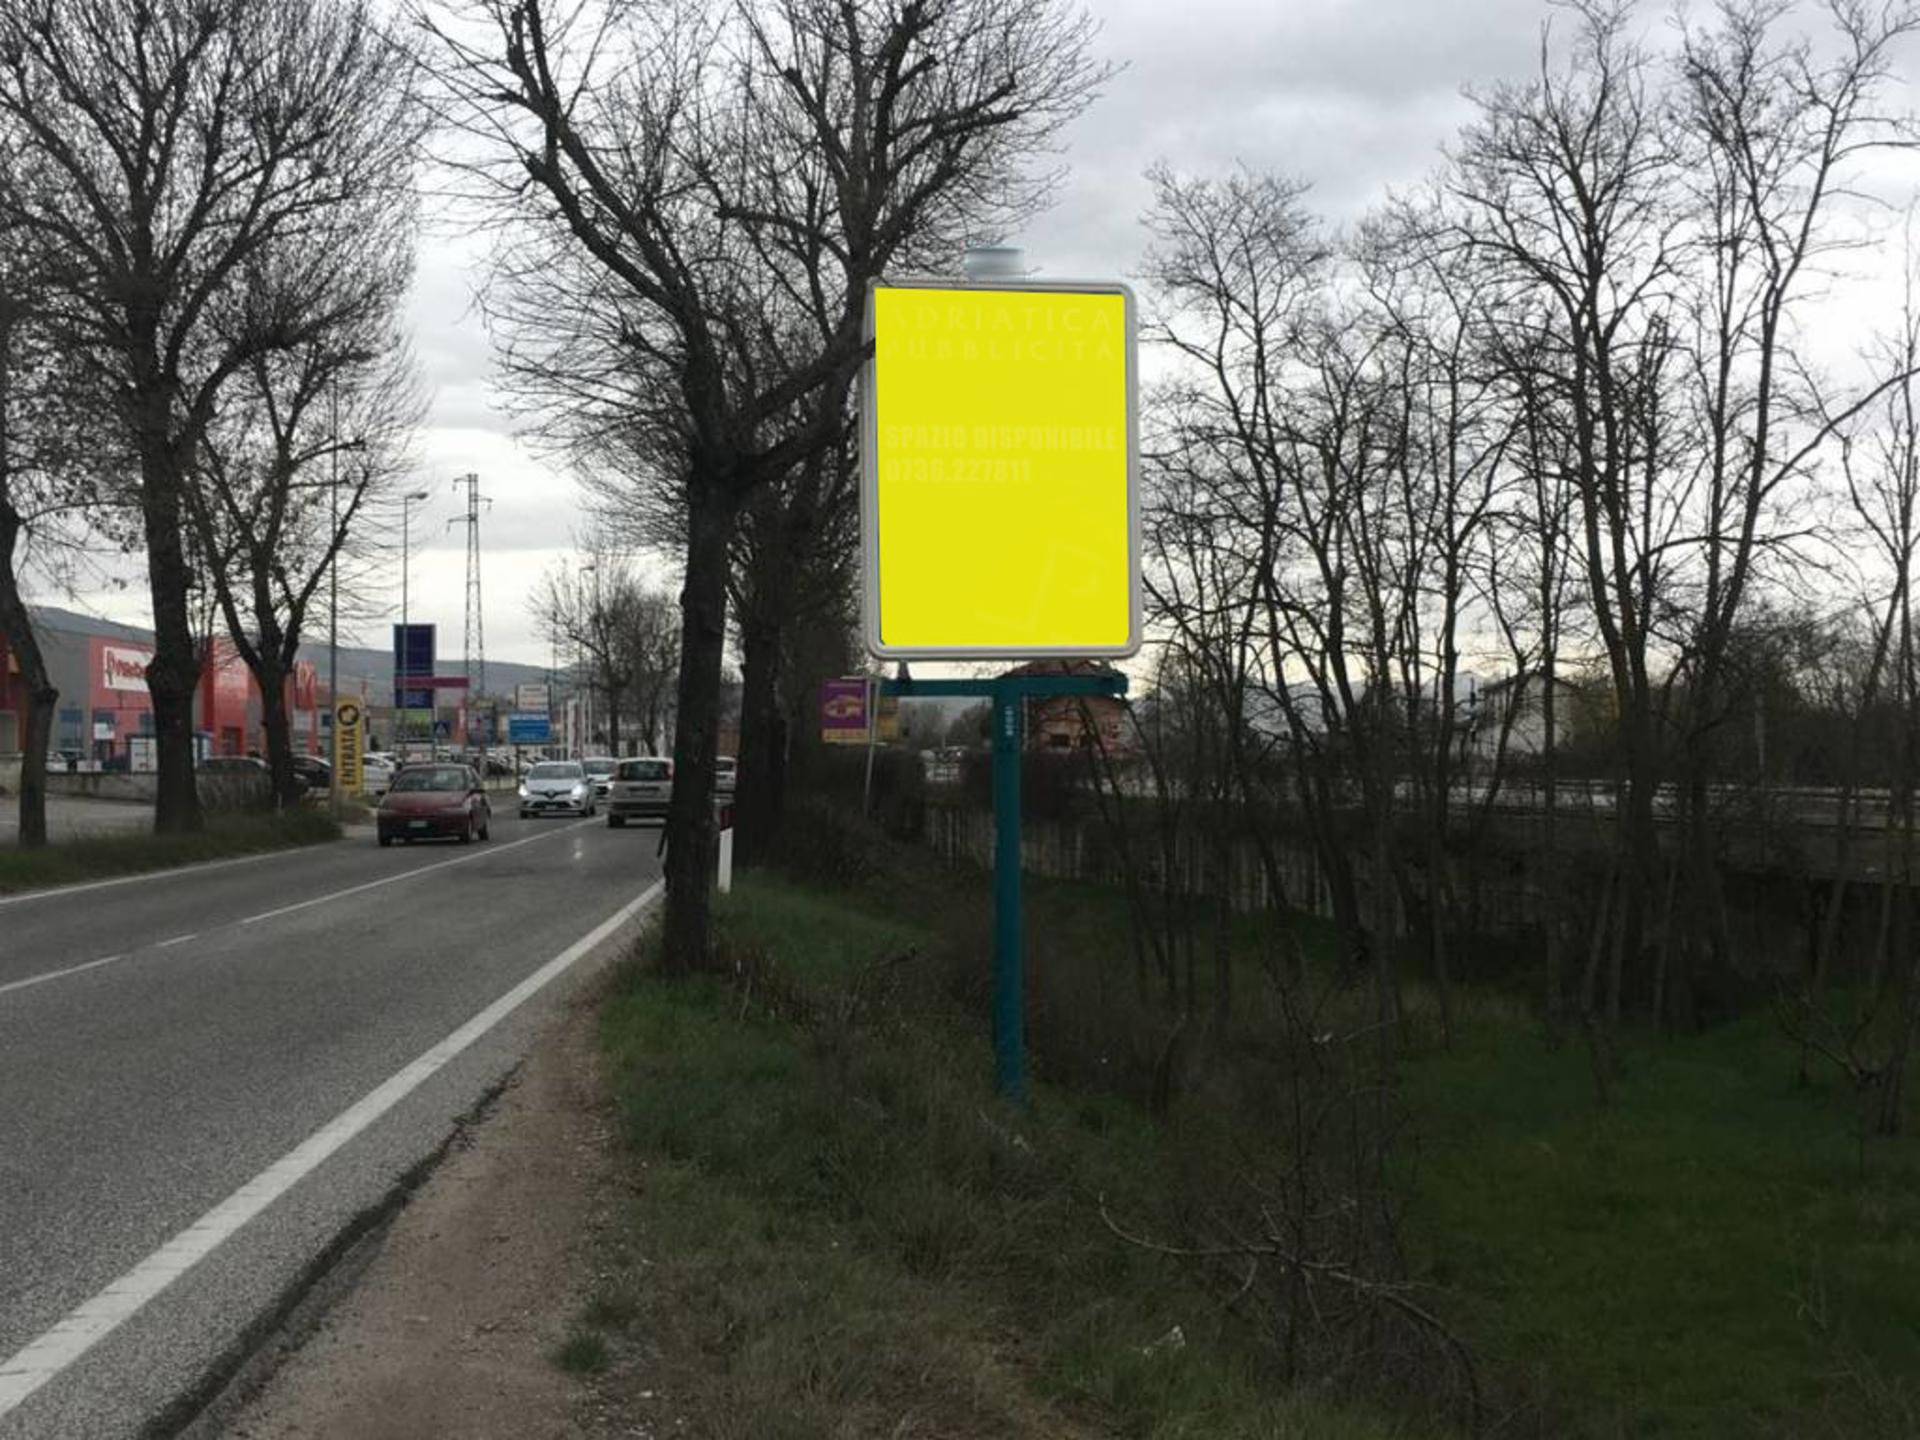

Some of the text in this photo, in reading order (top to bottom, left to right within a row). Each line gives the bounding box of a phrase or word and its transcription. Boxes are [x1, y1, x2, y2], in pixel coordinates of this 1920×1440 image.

[886, 424, 1117, 450] SPAZIO DISPONIBILE
[341, 728, 356, 786] ENTRATA
